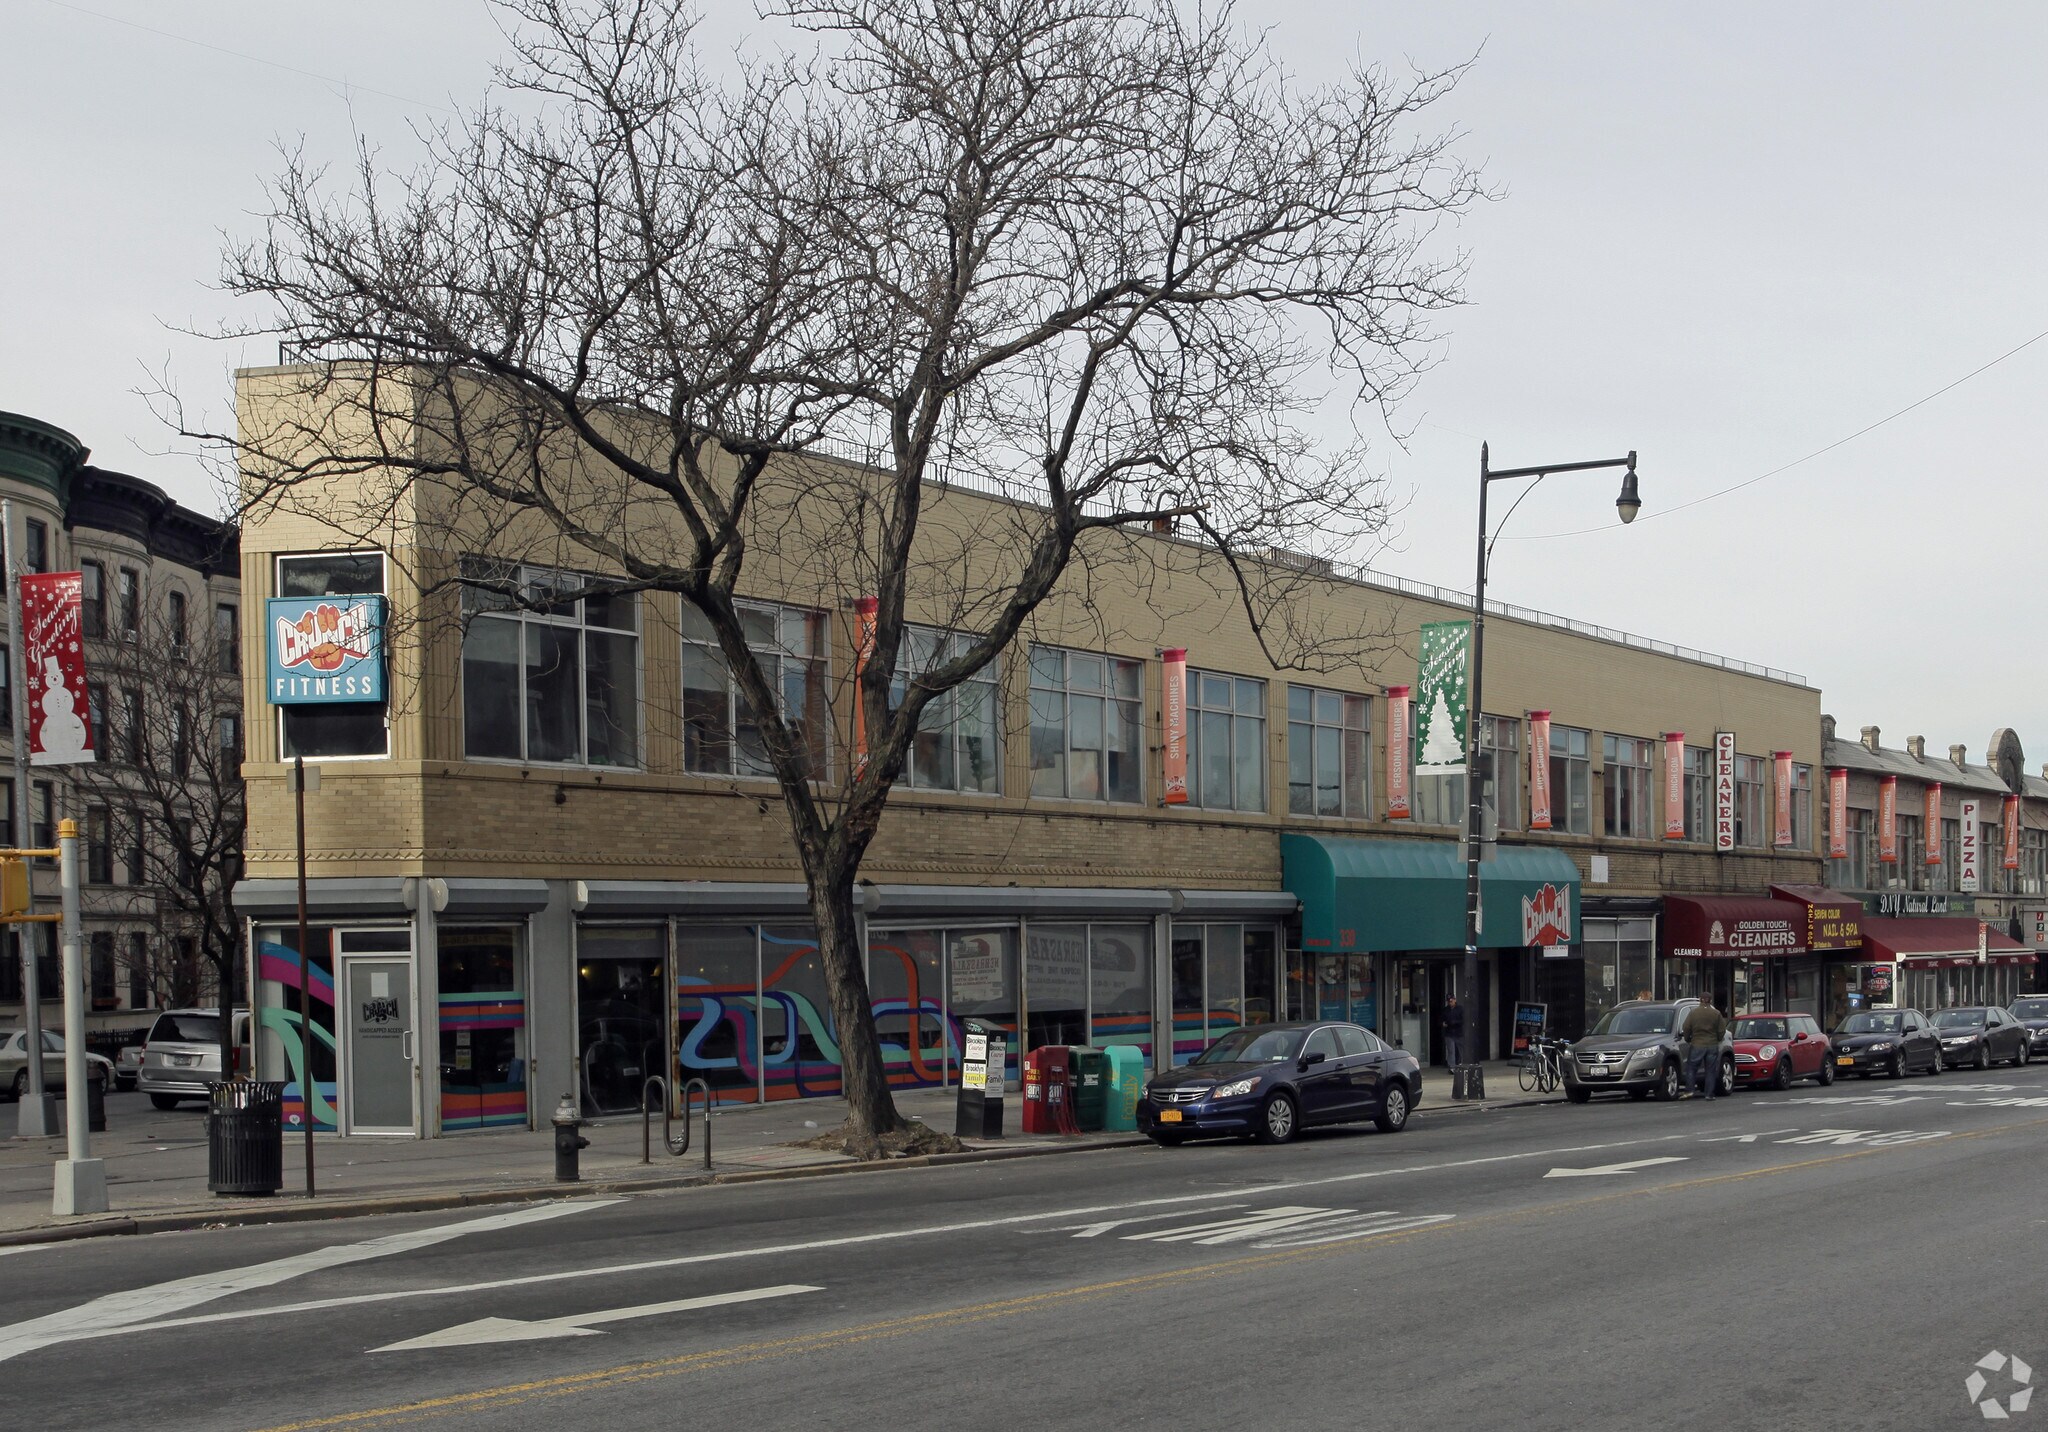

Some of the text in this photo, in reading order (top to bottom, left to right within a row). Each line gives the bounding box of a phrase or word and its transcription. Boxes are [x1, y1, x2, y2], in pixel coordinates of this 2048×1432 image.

[29, 581, 79, 641] Seasons
[27, 606, 77, 676] Greeting
[277, 602, 370, 668] CRUNCH
[1422, 627, 1469, 676] Seasons
[276, 677, 371, 697] FITNESS
[1419, 647, 1466, 704] Greeting
[1169, 675, 1179, 760] SHINY MACHINES
[1393, 701, 1403, 789] PERSONAL TRAINERS
[1536, 737, 1544, 769] CRUNCH
[1718, 736, 1732, 847] CLEANERS
[1963, 804, 1976, 879] PIZZA
[1522, 884, 1571, 947] CRUNCH
[1739, 920, 1787, 930] GOLDEN TOUCH
[1903, 895, 1928, 913] Natural
[1931, 895, 1947, 912] Land
[1673, 948, 1702, 957] CLEANERS
[1729, 931, 1796, 948] CLEANERS
[1823, 923, 1858, 937] NAIL & SPA
[362, 998, 398, 1021] CRUNCH
[966, 1063, 984, 1073] Brooklyn
[1121, 1074, 1137, 1120] family
